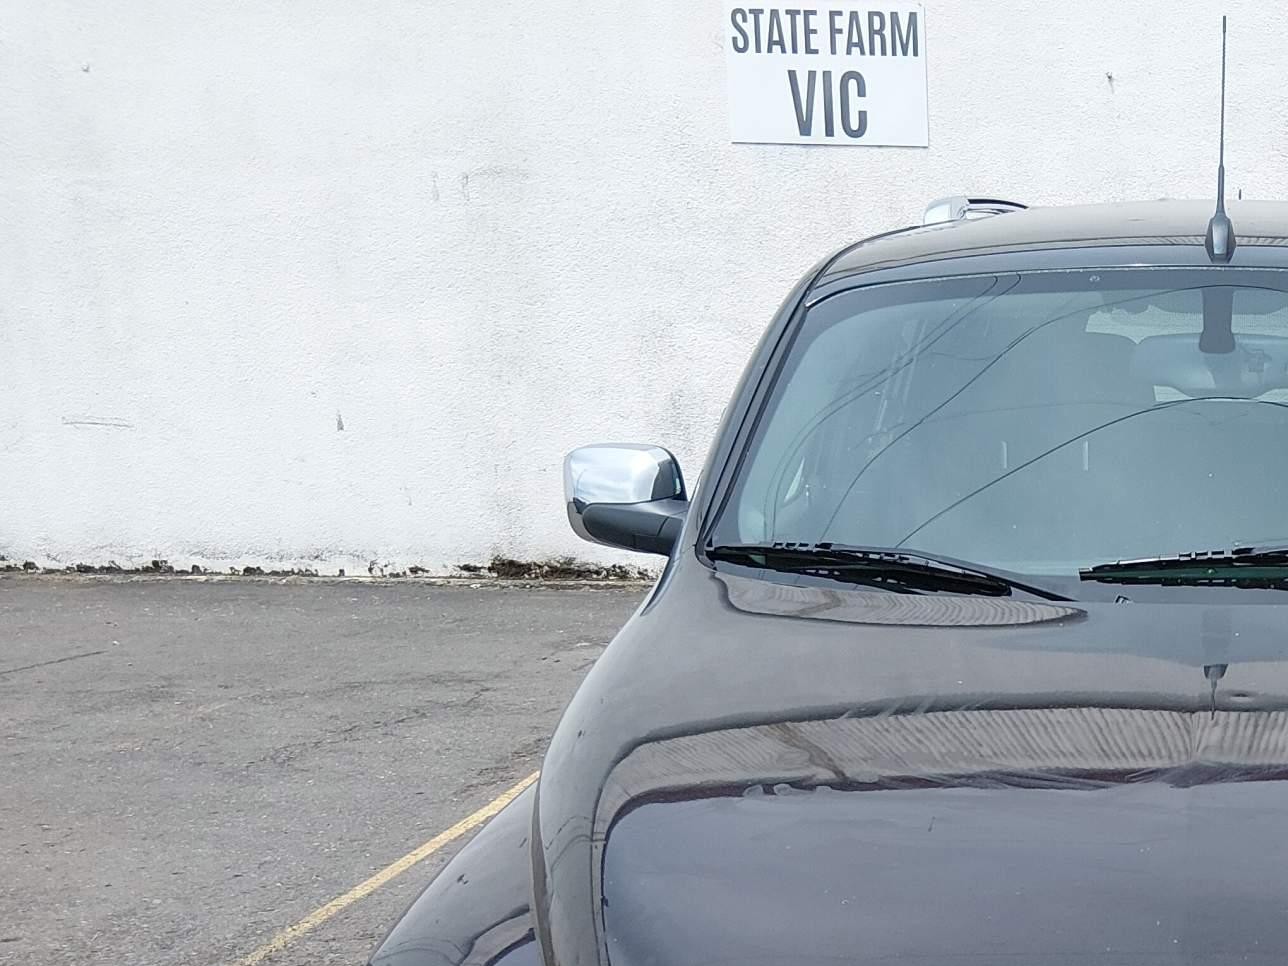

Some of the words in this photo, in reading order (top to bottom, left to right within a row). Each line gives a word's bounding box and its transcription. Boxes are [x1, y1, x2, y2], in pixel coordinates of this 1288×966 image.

[731, 8, 819, 54] STATE
[829, 10, 919, 57] FARM
[787, 70, 868, 138] VIC
